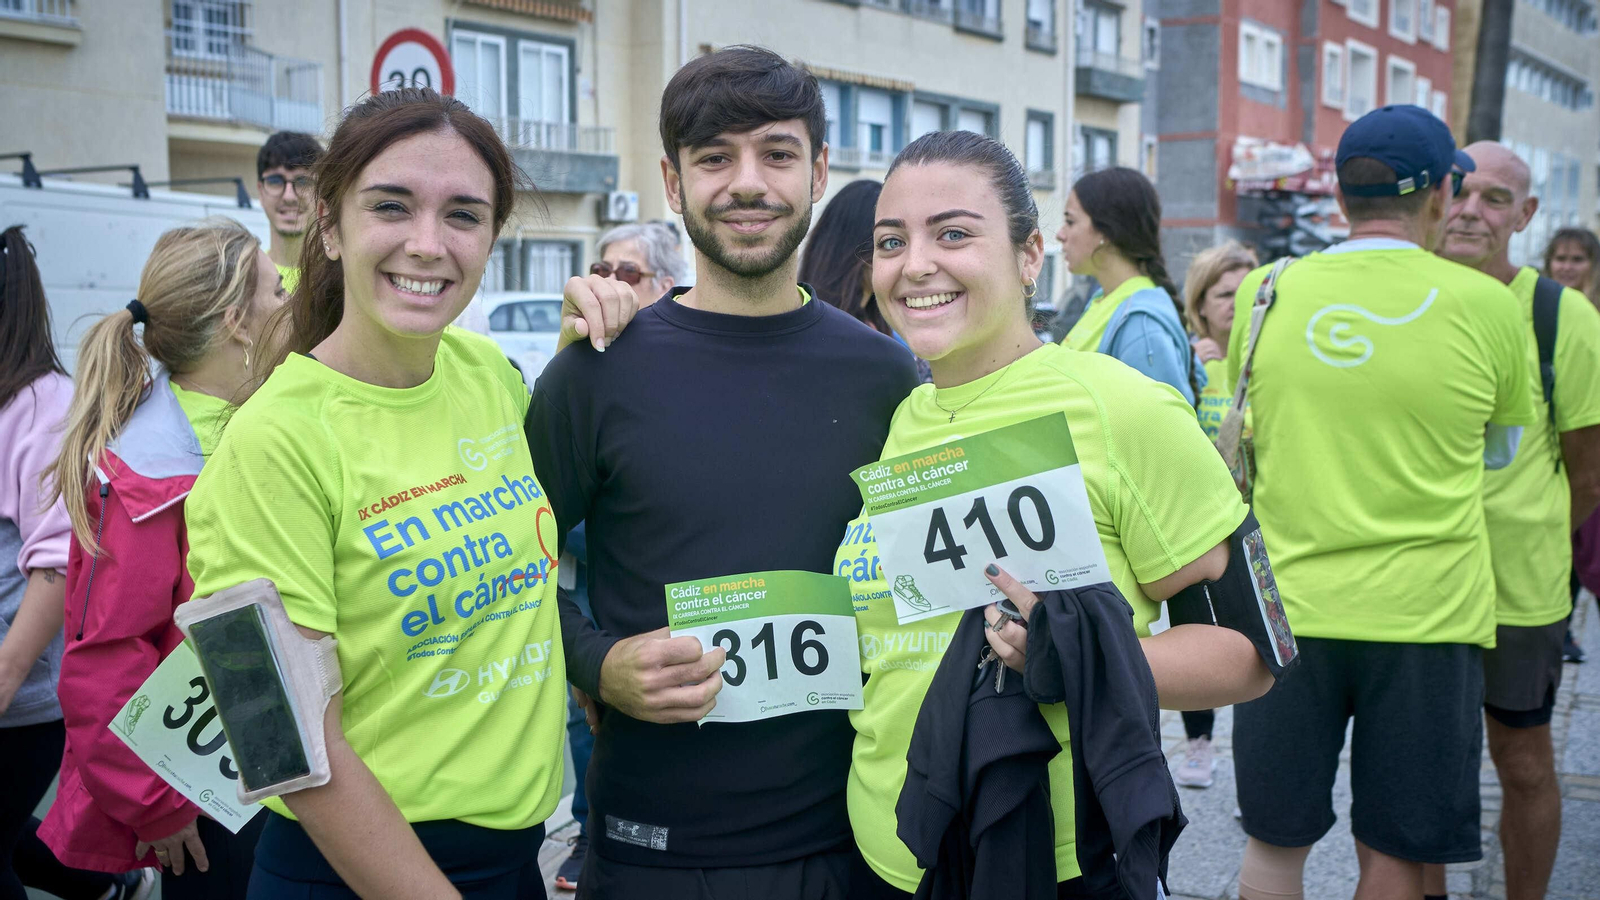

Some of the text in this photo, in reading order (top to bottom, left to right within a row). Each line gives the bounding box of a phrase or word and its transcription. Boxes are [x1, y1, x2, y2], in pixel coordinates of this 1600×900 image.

[859, 446, 965, 482] Cádiz en marcha
[867, 459, 969, 495] contra el cáncer
[358, 473, 467, 521] IX CÁDIZ EN MARCHA
[873, 492, 897, 503] CARRERA
[896, 486, 920, 498] CONTRA
[927, 477, 952, 489] CÁNCER
[362, 475, 543, 560] En marcha
[923, 485, 1056, 571] 410
[387, 532, 513, 597] contra
[401, 556, 550, 637] el cáncer
[670, 577, 766, 599] Cádiz en marcha
[674, 589, 767, 611] contra el cáncer
[678, 610, 700, 619] CARRERA
[700, 607, 721, 615] CONTRA
[728, 602, 750, 611] CÁNCER
[406, 633, 459, 655] ASOCIACIÓN
[712, 620, 829, 687] 316
